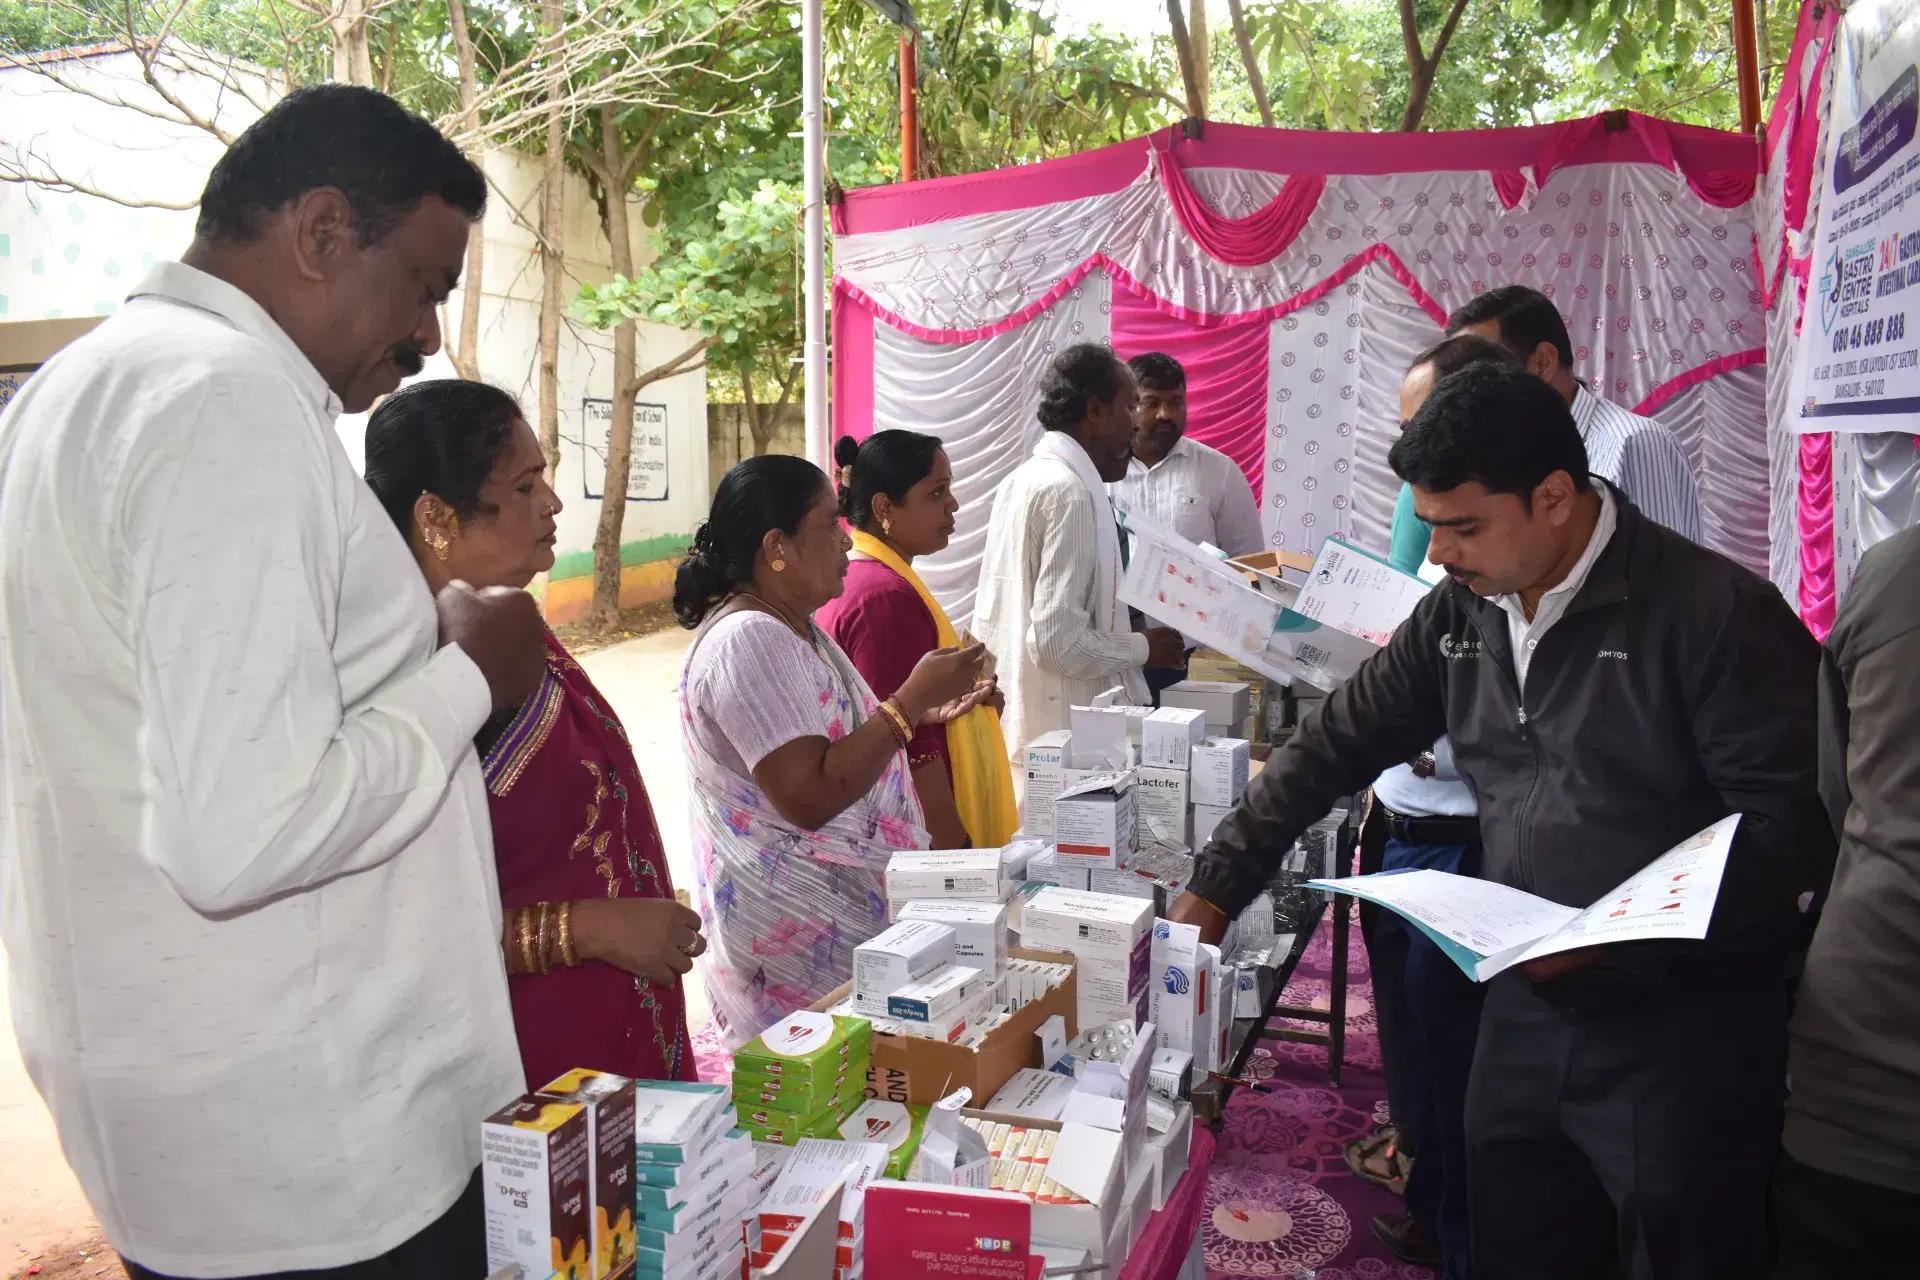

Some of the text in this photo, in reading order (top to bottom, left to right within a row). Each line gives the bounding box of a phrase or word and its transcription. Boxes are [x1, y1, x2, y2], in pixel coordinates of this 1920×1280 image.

[1879, 232, 1898, 272] 24/7
[1844, 253, 1873, 281] GASTRO
[1842, 275, 1872, 302] CENTRE
[1876, 266, 1906, 298] INTESTINAL
[1840, 298, 1869, 318] HOSPITALS
[1833, 312, 1904, 353] 080 46 888 888
[1869, 355, 1889, 373] LAYOUT
[1835, 382, 1861, 399] BANGALORE
[587, 404, 600, 419] The
[1029, 752, 1060, 763] Prolar
[1138, 777, 1179, 789] Lactofer
[886, 1068, 908, 1104] AND
[975, 1237, 1011, 1251] adek
[911, 1250, 937, 1262] Tablets
[940, 1252, 967, 1265] Extract
[992, 1258, 1025, 1270] Curcuma
[927, 1260, 1024, 1280] Multivitamin with Zinc and
